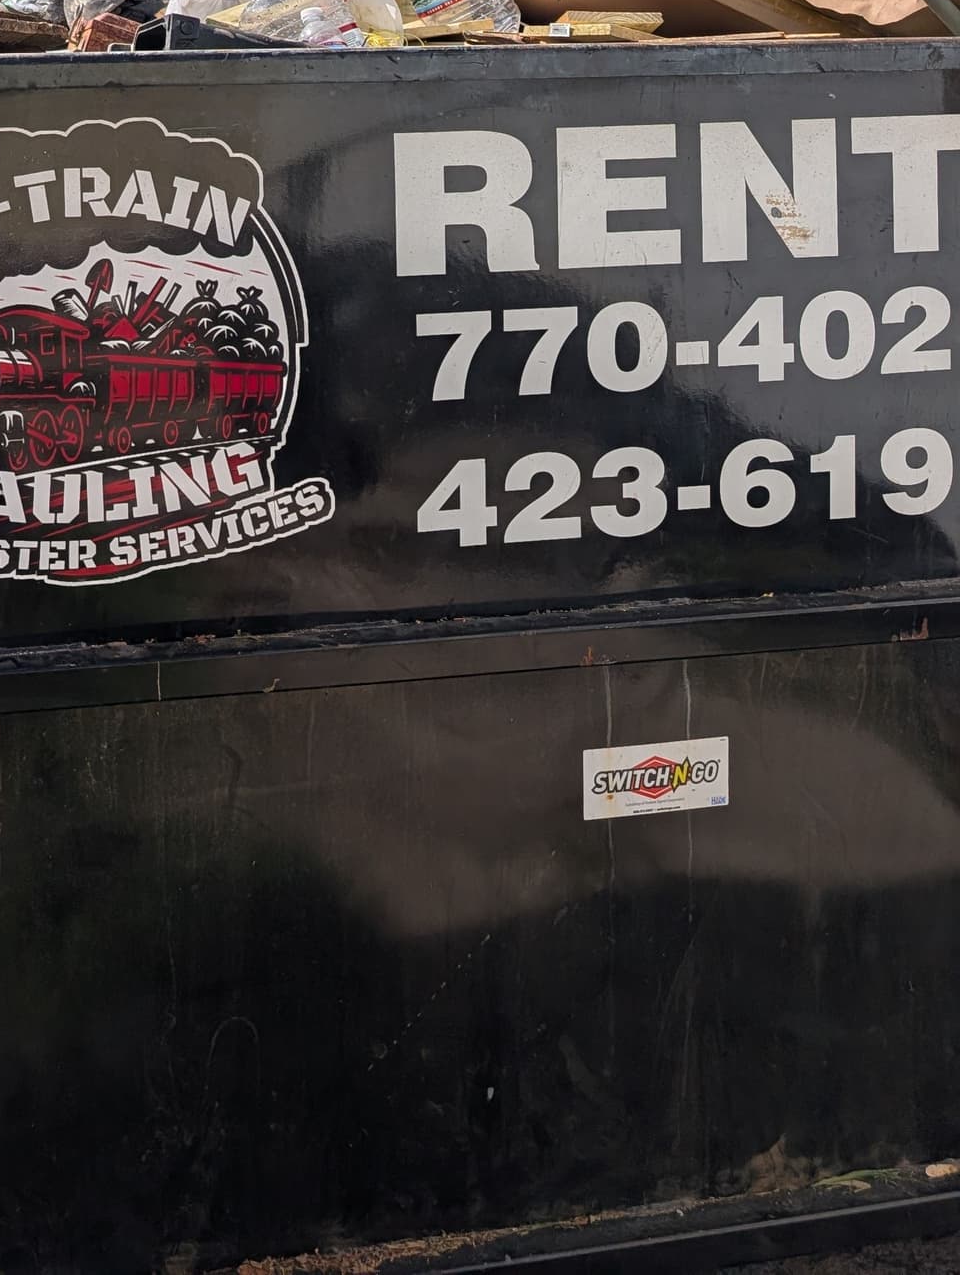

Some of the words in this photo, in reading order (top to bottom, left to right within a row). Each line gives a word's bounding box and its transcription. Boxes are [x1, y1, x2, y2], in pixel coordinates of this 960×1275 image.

[393, 114, 960, 277] RENT
[415, 286, 952, 402] 770-402
[109, 484, 325, 567] SERVICES
[416, 427, 954, 548] 423-619
